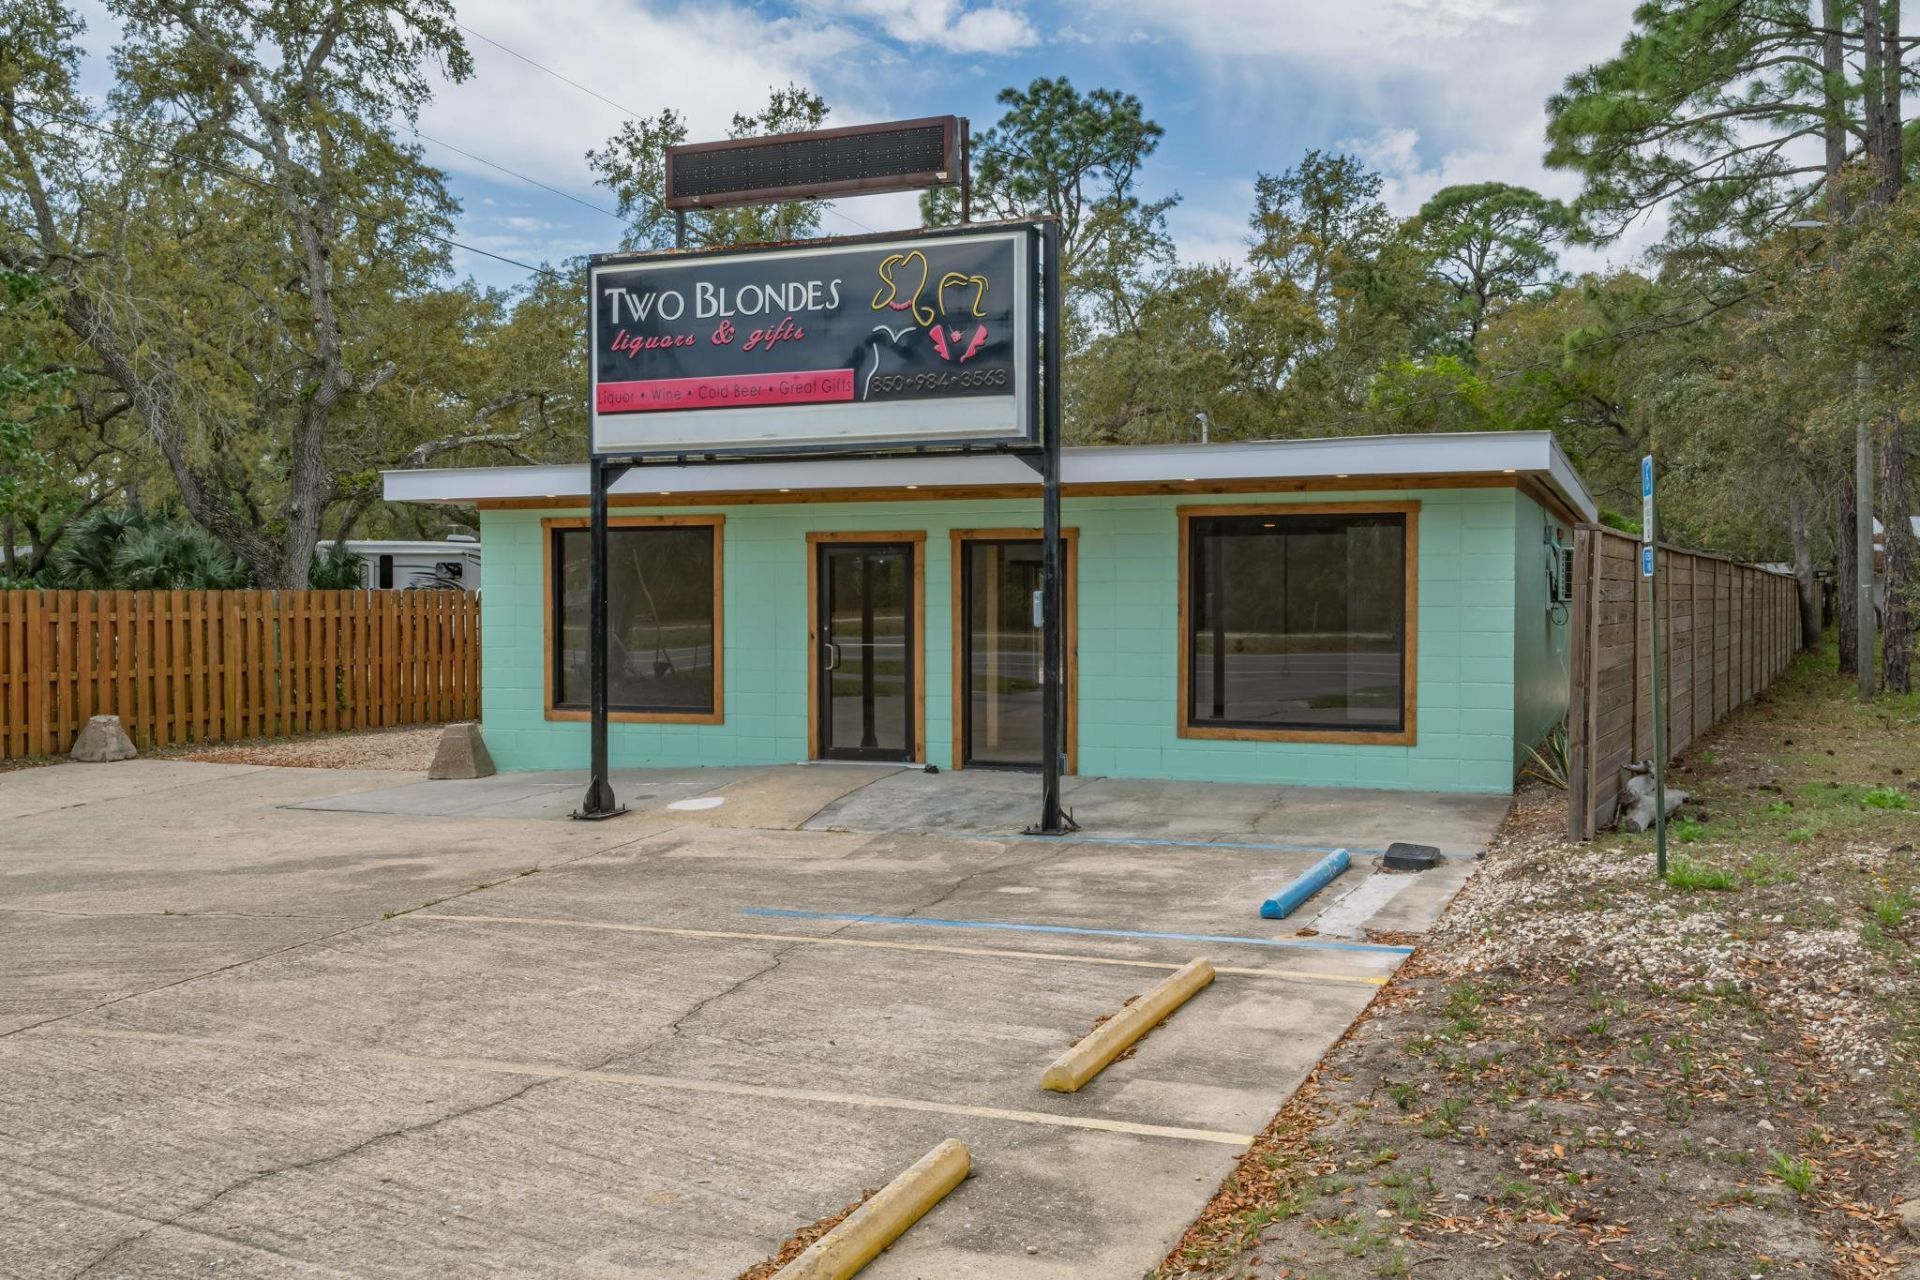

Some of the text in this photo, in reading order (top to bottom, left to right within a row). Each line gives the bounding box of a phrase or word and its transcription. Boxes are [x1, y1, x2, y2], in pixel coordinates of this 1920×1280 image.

[611, 316, 805, 359] liquors & gifts
[597, 377, 853, 406] Liquor Wine Cold Beer Great Gifts
